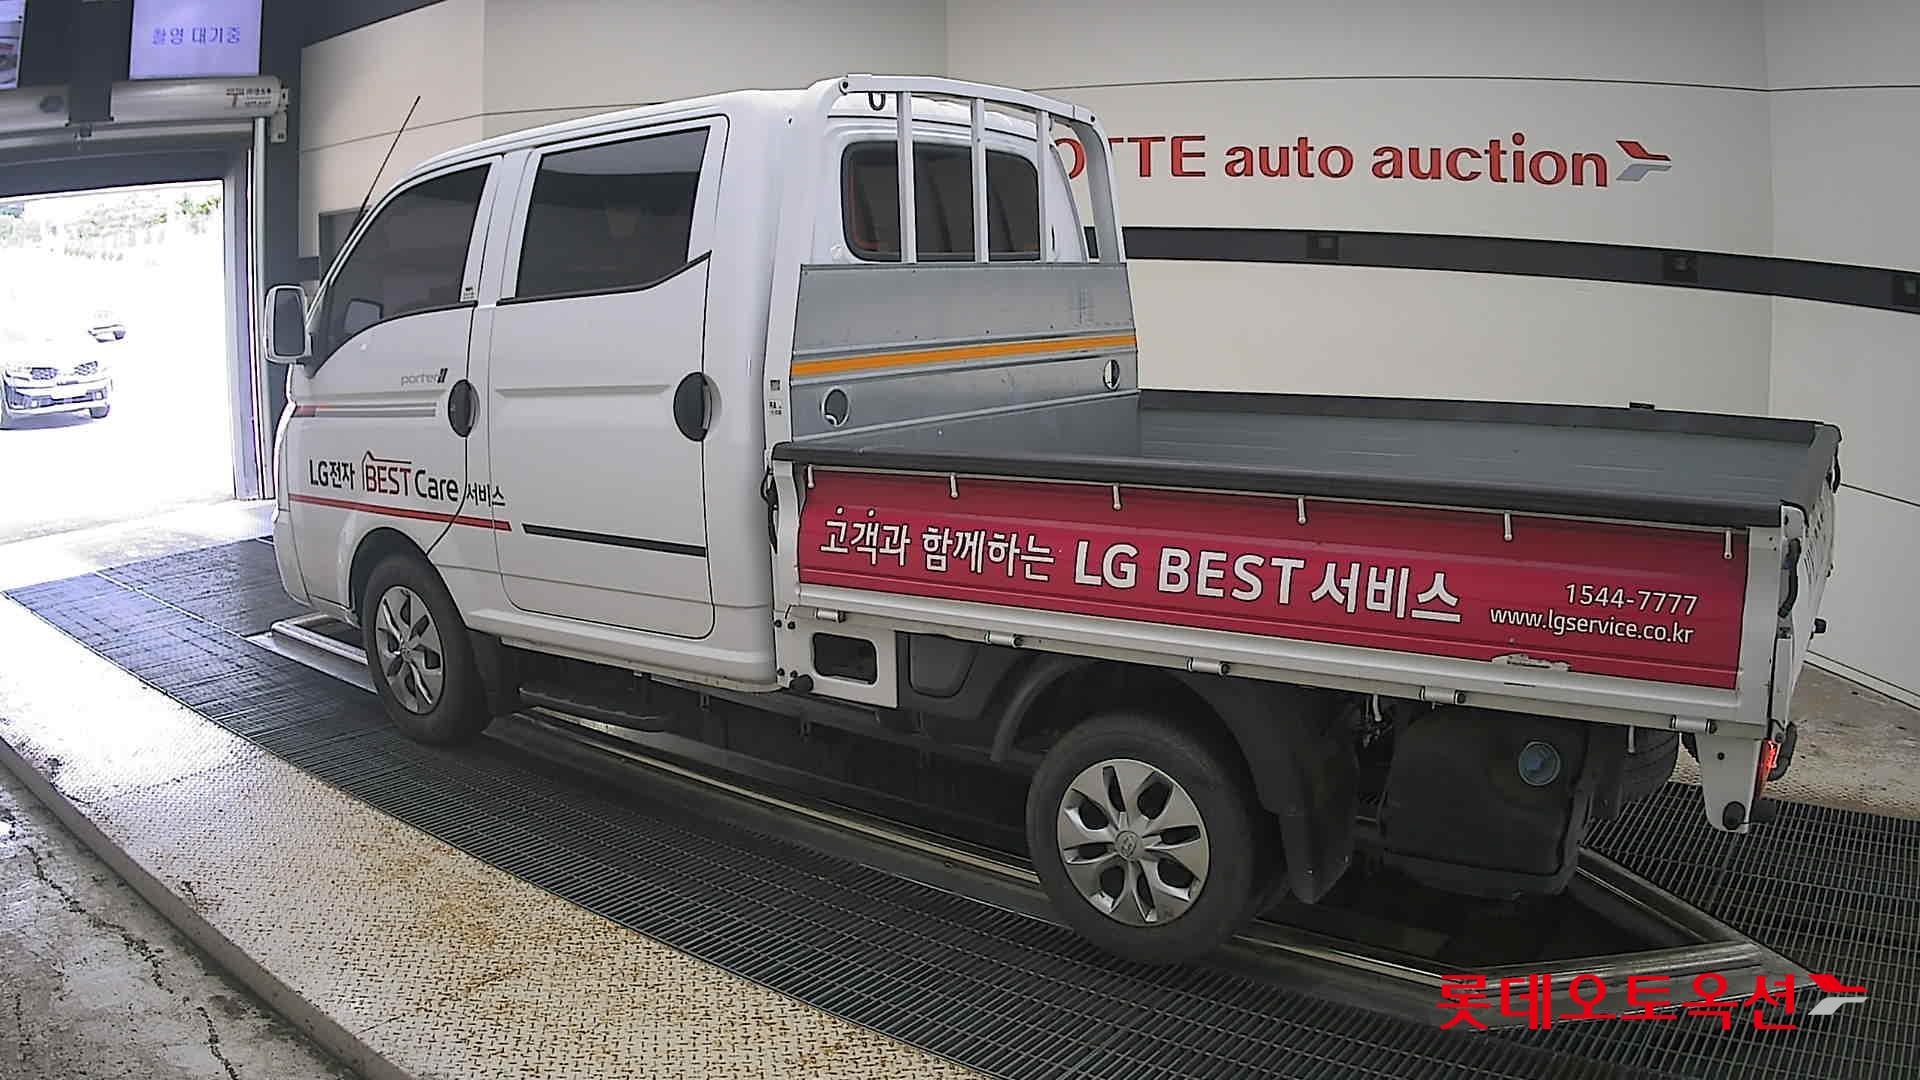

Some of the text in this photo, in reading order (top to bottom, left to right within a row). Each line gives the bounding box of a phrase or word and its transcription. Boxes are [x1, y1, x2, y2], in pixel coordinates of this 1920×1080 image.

[192, 27, 241, 45] 대기중
[1224, 137, 1354, 178] auto
[1371, 133, 1608, 187] auction
[309, 459, 506, 507] LG전자 BEST Care 서비스
[820, 514, 1462, 624] 고객과 함께하는 LG BEST 서비스
[1565, 583, 1698, 616] 1544-7777
[1489, 607, 1694, 644] www.lgservice.co.kr
